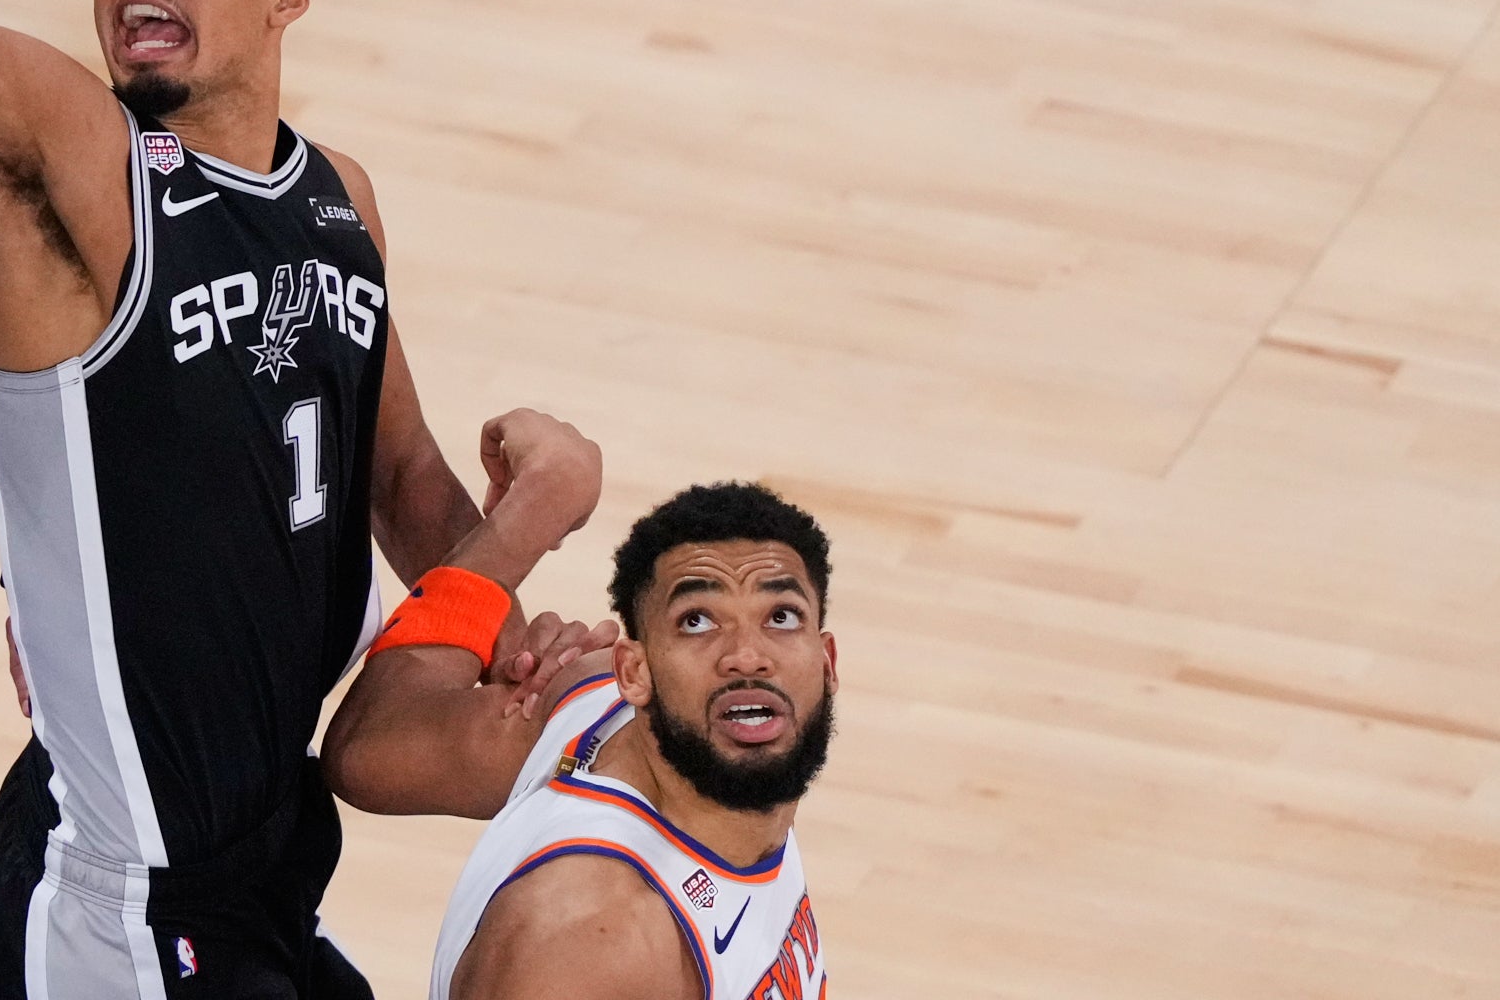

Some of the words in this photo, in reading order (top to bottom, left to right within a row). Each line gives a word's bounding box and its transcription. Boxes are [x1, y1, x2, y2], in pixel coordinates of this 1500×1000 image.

[145, 137, 177, 148] USA
[148, 153, 182, 165] 250
[318, 205, 359, 222] LEDGER
[169, 258, 385, 384] SPURS
[282, 397, 328, 533] 1
[684, 873, 707, 894] USA
[693, 884, 719, 910] 250
